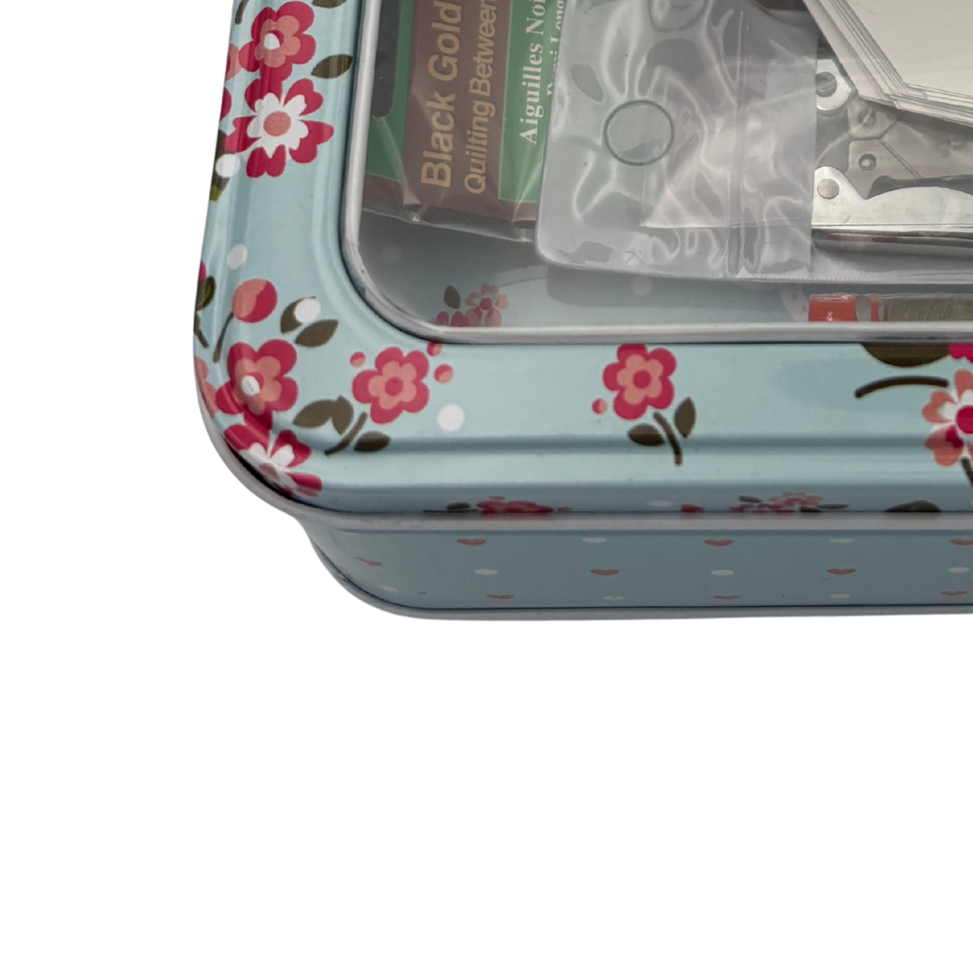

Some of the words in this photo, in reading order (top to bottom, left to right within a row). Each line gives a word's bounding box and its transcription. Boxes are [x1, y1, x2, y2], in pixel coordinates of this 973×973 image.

[428, 0, 463, 81] Gold
[421, 89, 456, 188] Black
[519, 43, 544, 145] Aiguilles
[464, 100, 496, 194] Quilting
